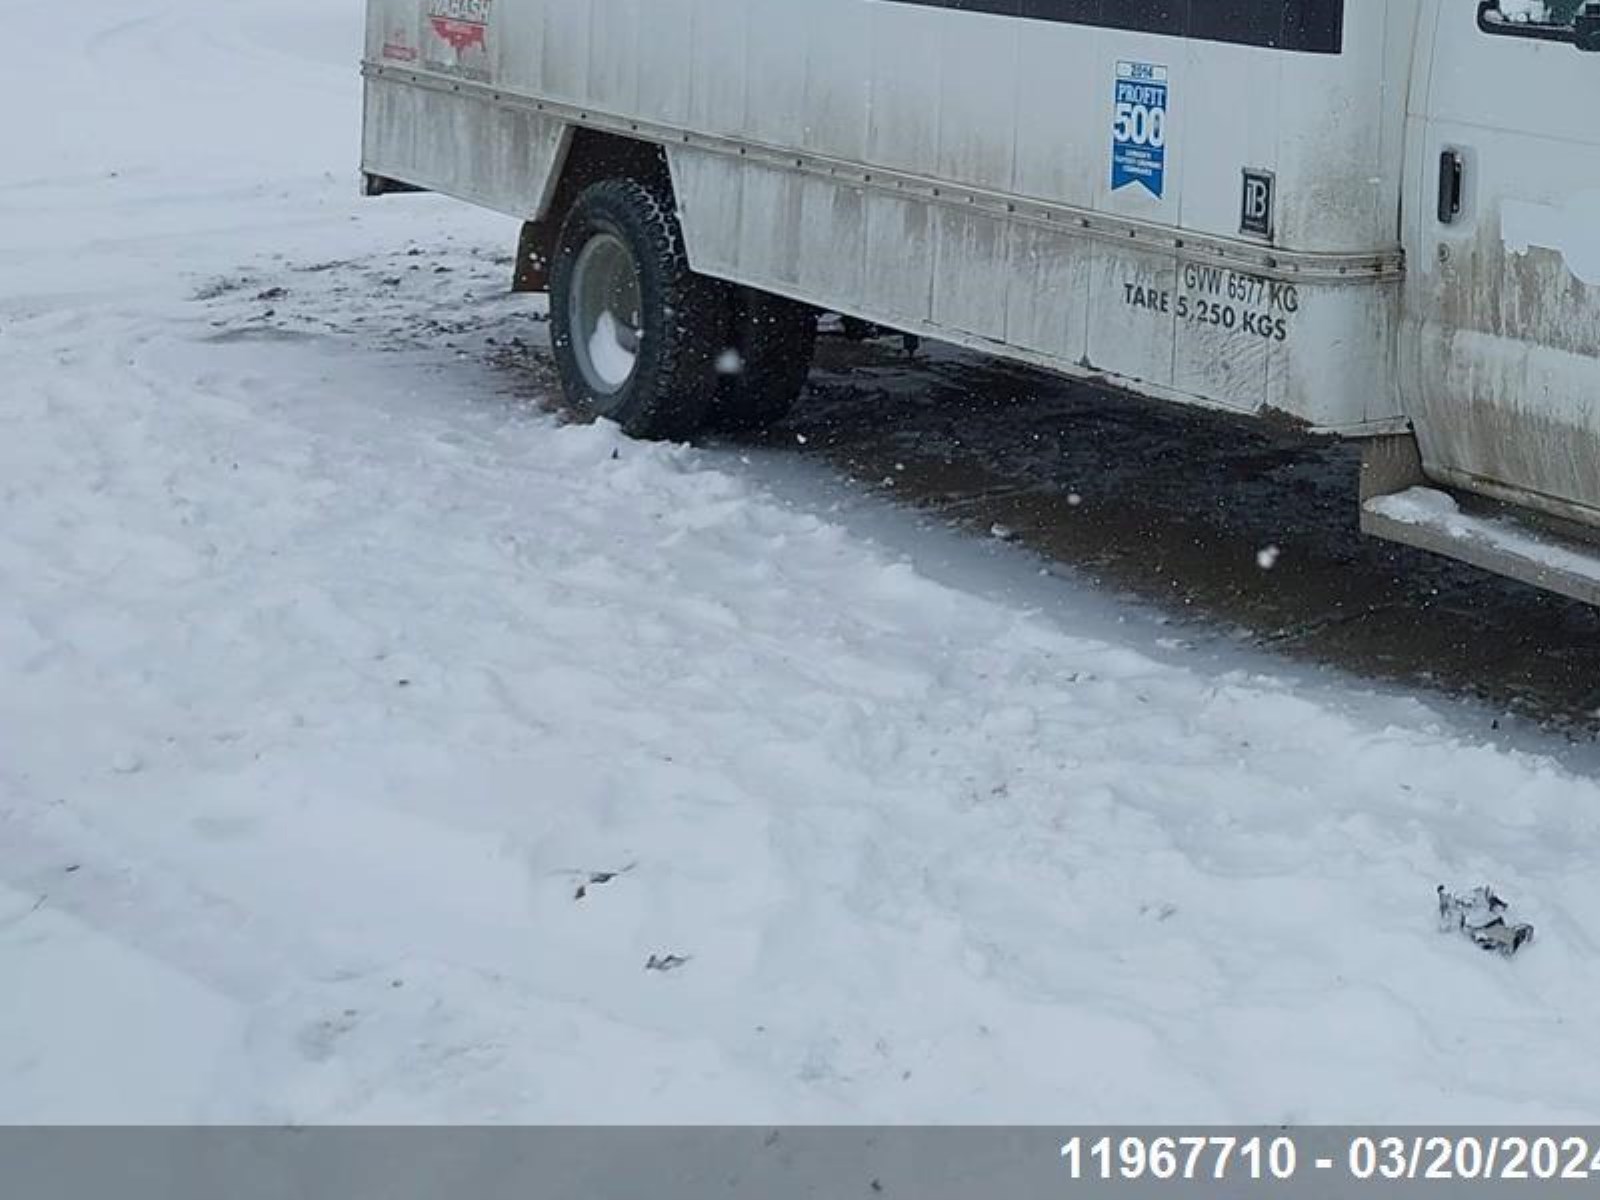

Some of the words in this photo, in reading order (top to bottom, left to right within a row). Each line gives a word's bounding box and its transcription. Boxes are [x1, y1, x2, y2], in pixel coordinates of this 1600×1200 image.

[1118, 83, 1166, 106] PROFIT
[1113, 102, 1164, 148] 500
[1184, 263, 1223, 296] GVW
[1227, 272, 1265, 305] 6577
[1269, 282, 1298, 312] KG
[1124, 283, 1169, 313] TARE
[1176, 295, 1236, 328] 5,250
[1243, 310, 1287, 341] KGS
